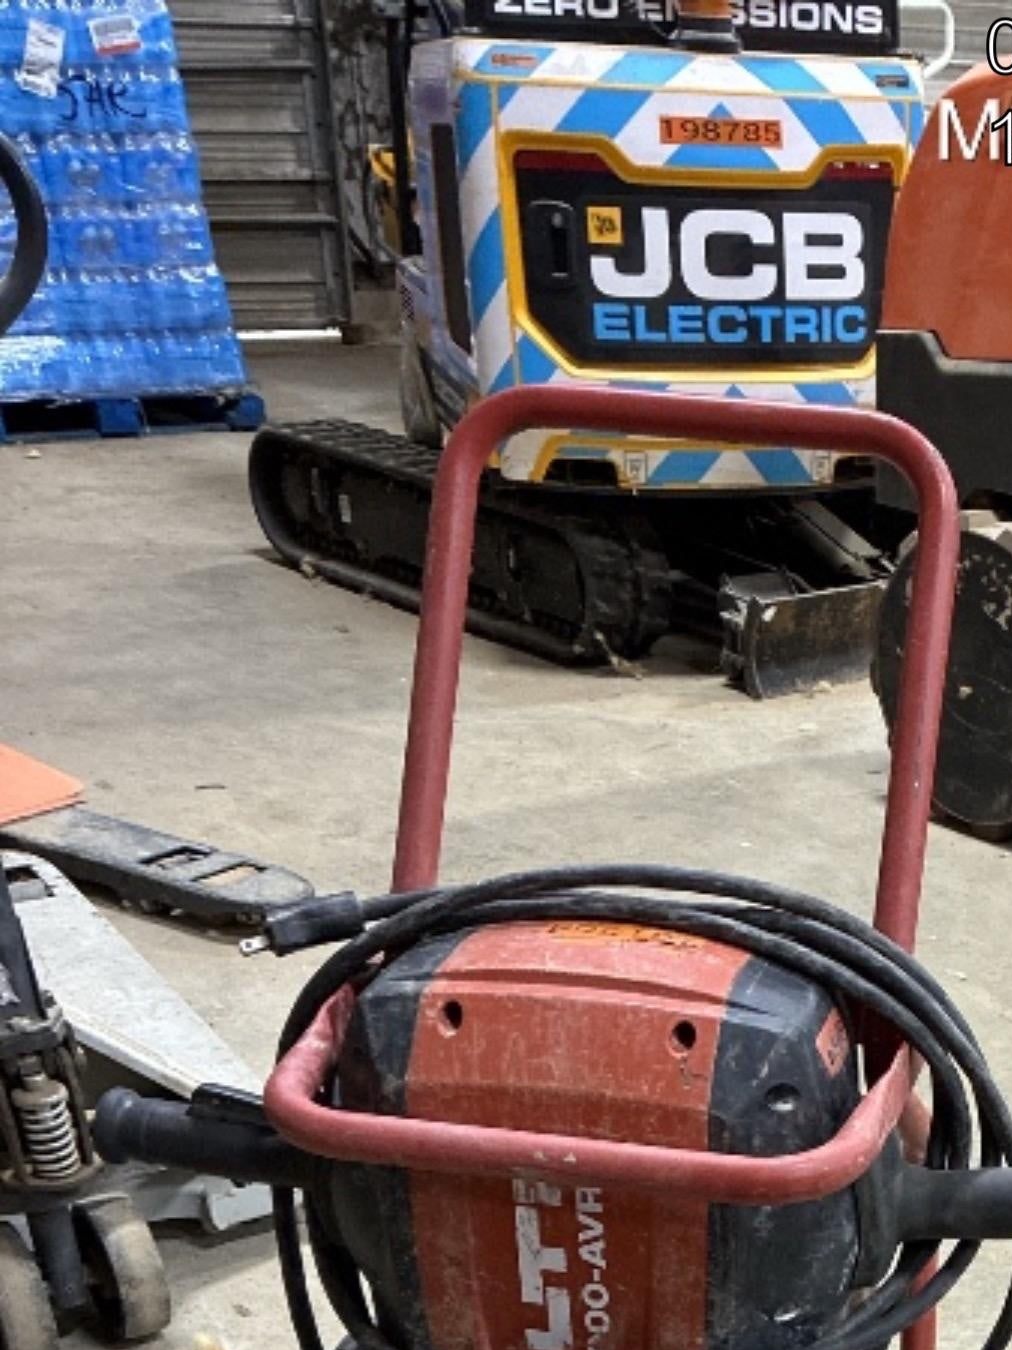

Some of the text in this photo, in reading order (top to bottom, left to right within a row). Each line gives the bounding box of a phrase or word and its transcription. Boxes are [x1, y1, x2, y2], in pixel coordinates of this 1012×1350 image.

[638, 0, 883, 34] ESSIONS
[660, 118, 782, 145] 198785
[589, 206, 866, 301] JCB
[592, 302, 868, 344] ELECTRIC
